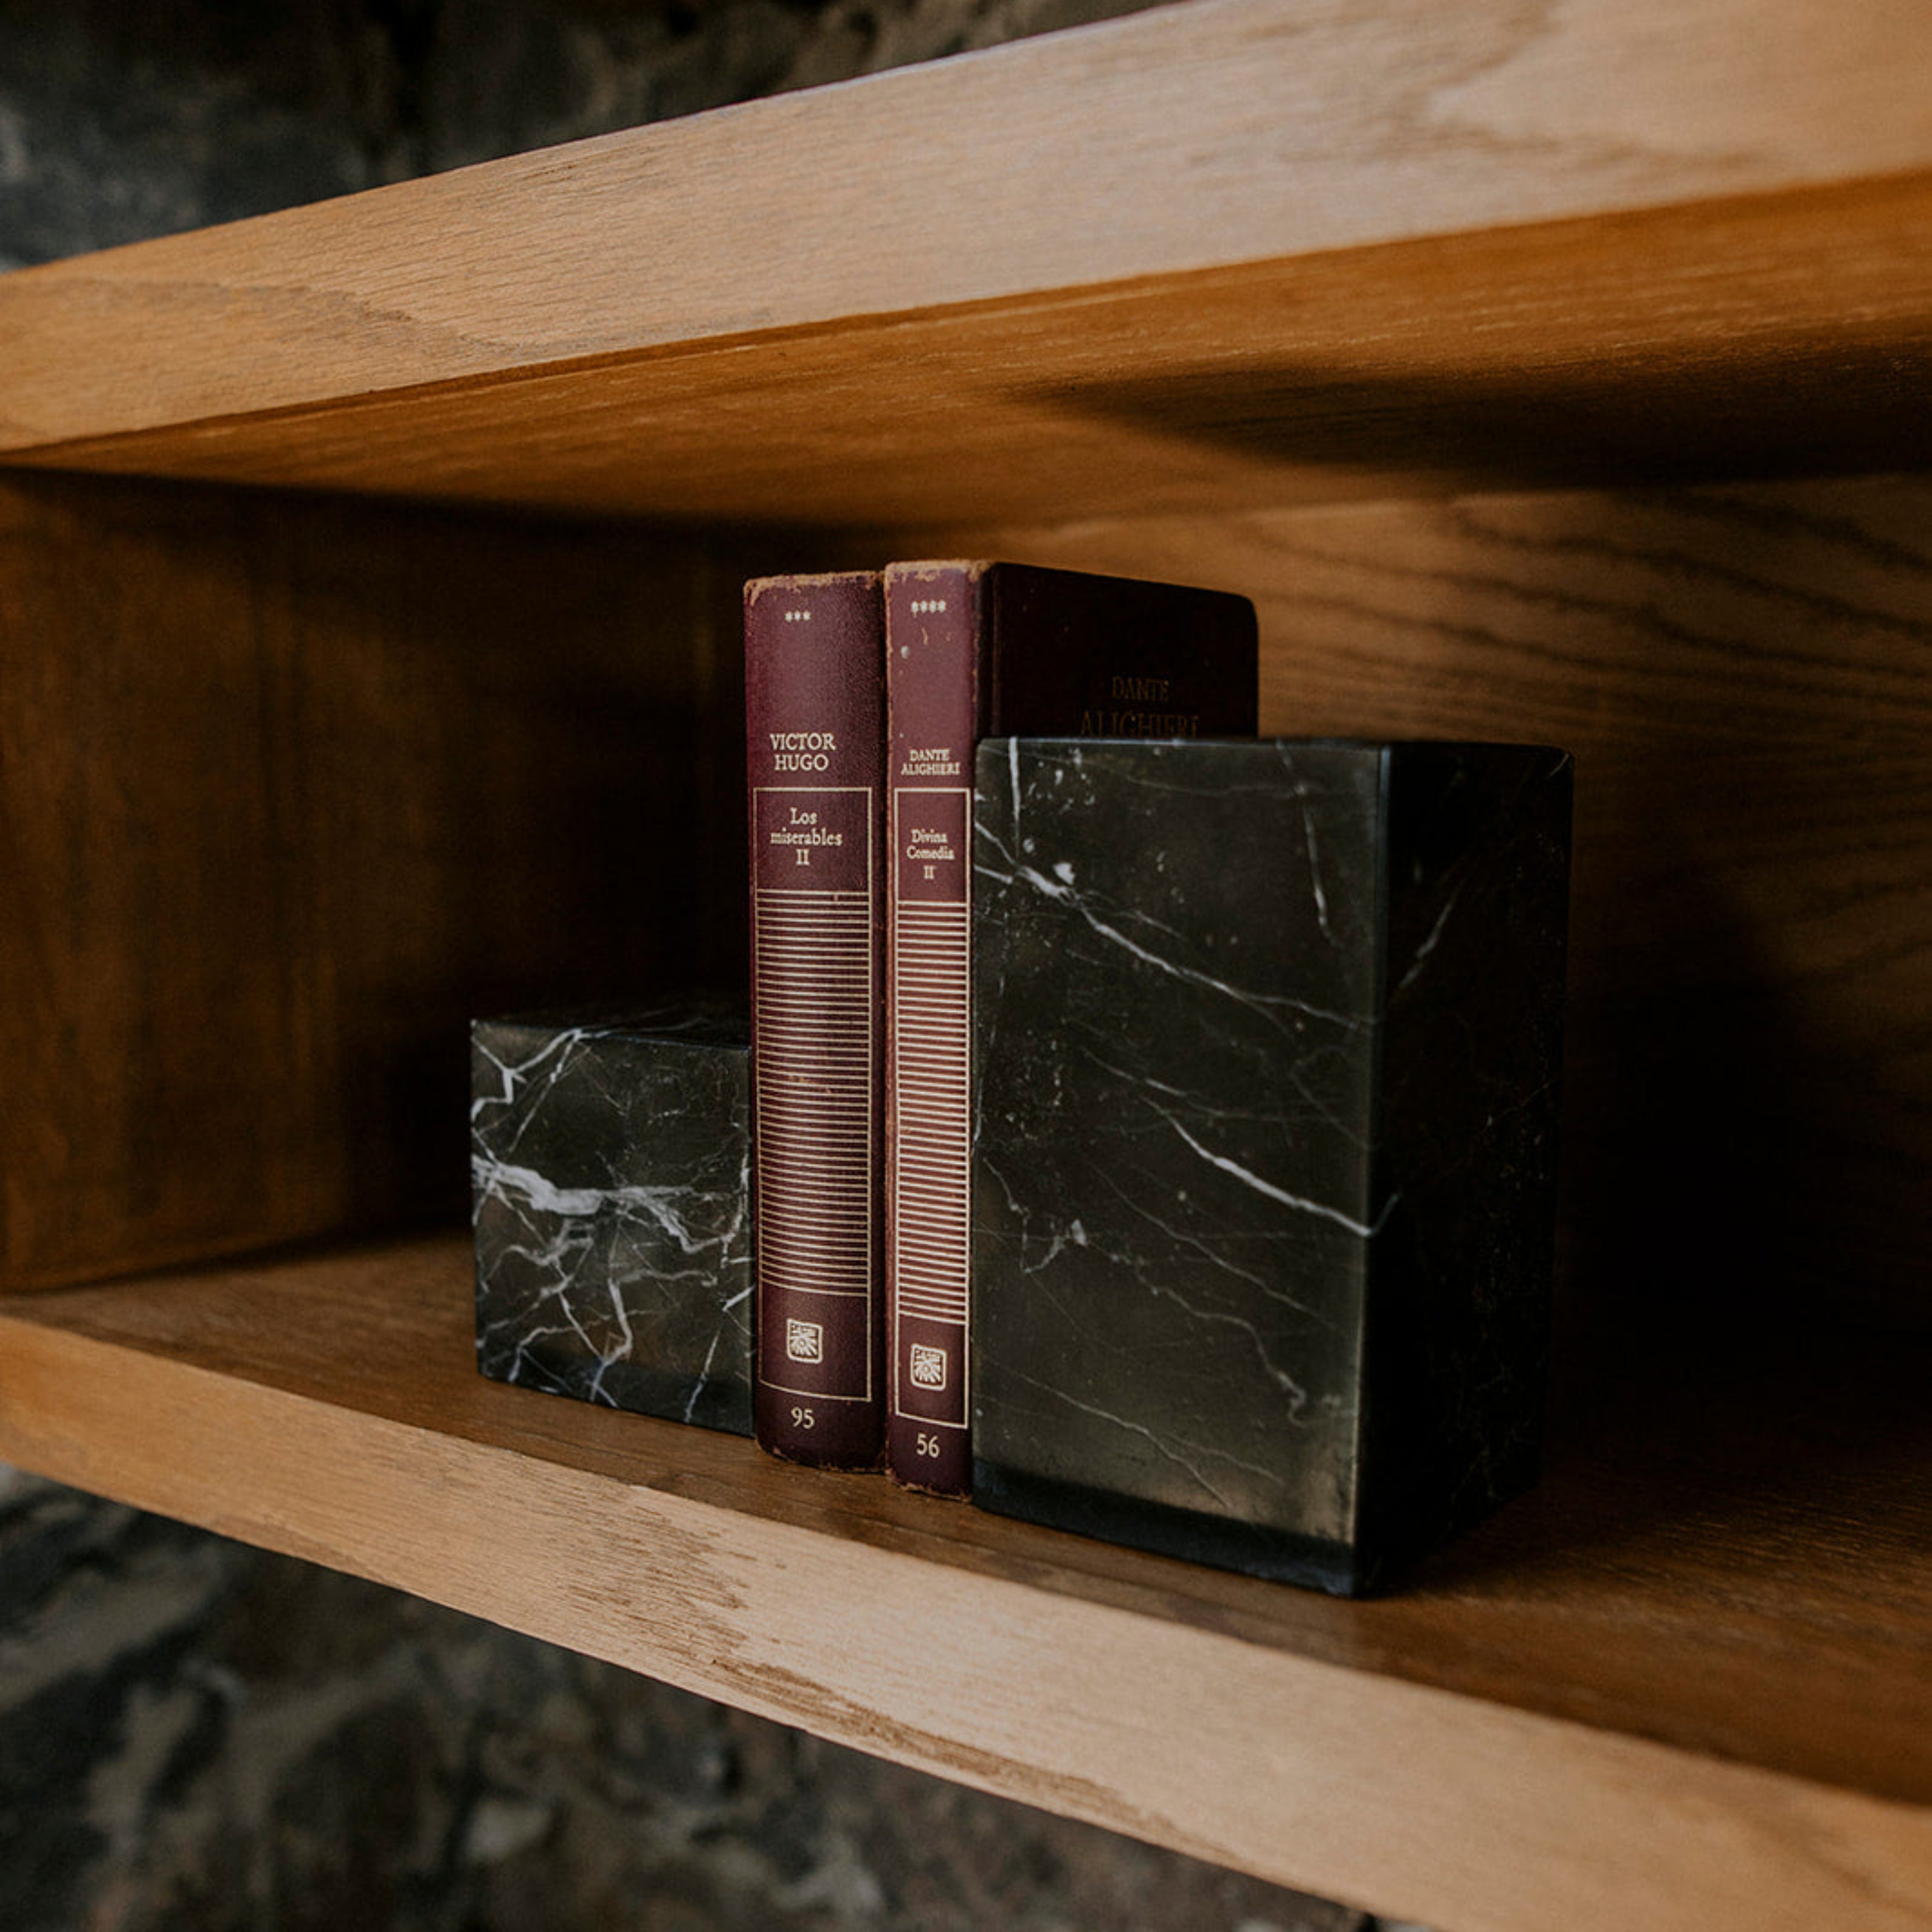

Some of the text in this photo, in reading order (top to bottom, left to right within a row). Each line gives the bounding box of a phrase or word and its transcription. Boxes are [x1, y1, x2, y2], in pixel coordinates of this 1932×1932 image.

[1110, 674, 1170, 702] DANTE
[769, 733, 837, 751] VICTOR
[774, 754, 829, 771] HUGO
[909, 749, 950, 761] DANTE
[901, 762, 961, 776] ALIGHIERI
[790, 807, 817, 825] Los
[770, 827, 843, 846] miserables
[911, 829, 948, 843] Divina
[796, 849, 810, 866] II
[906, 846, 954, 860] Comedia
[923, 865, 937, 879] II
[791, 1407, 815, 1429] 95
[916, 1433, 940, 1458] 56
